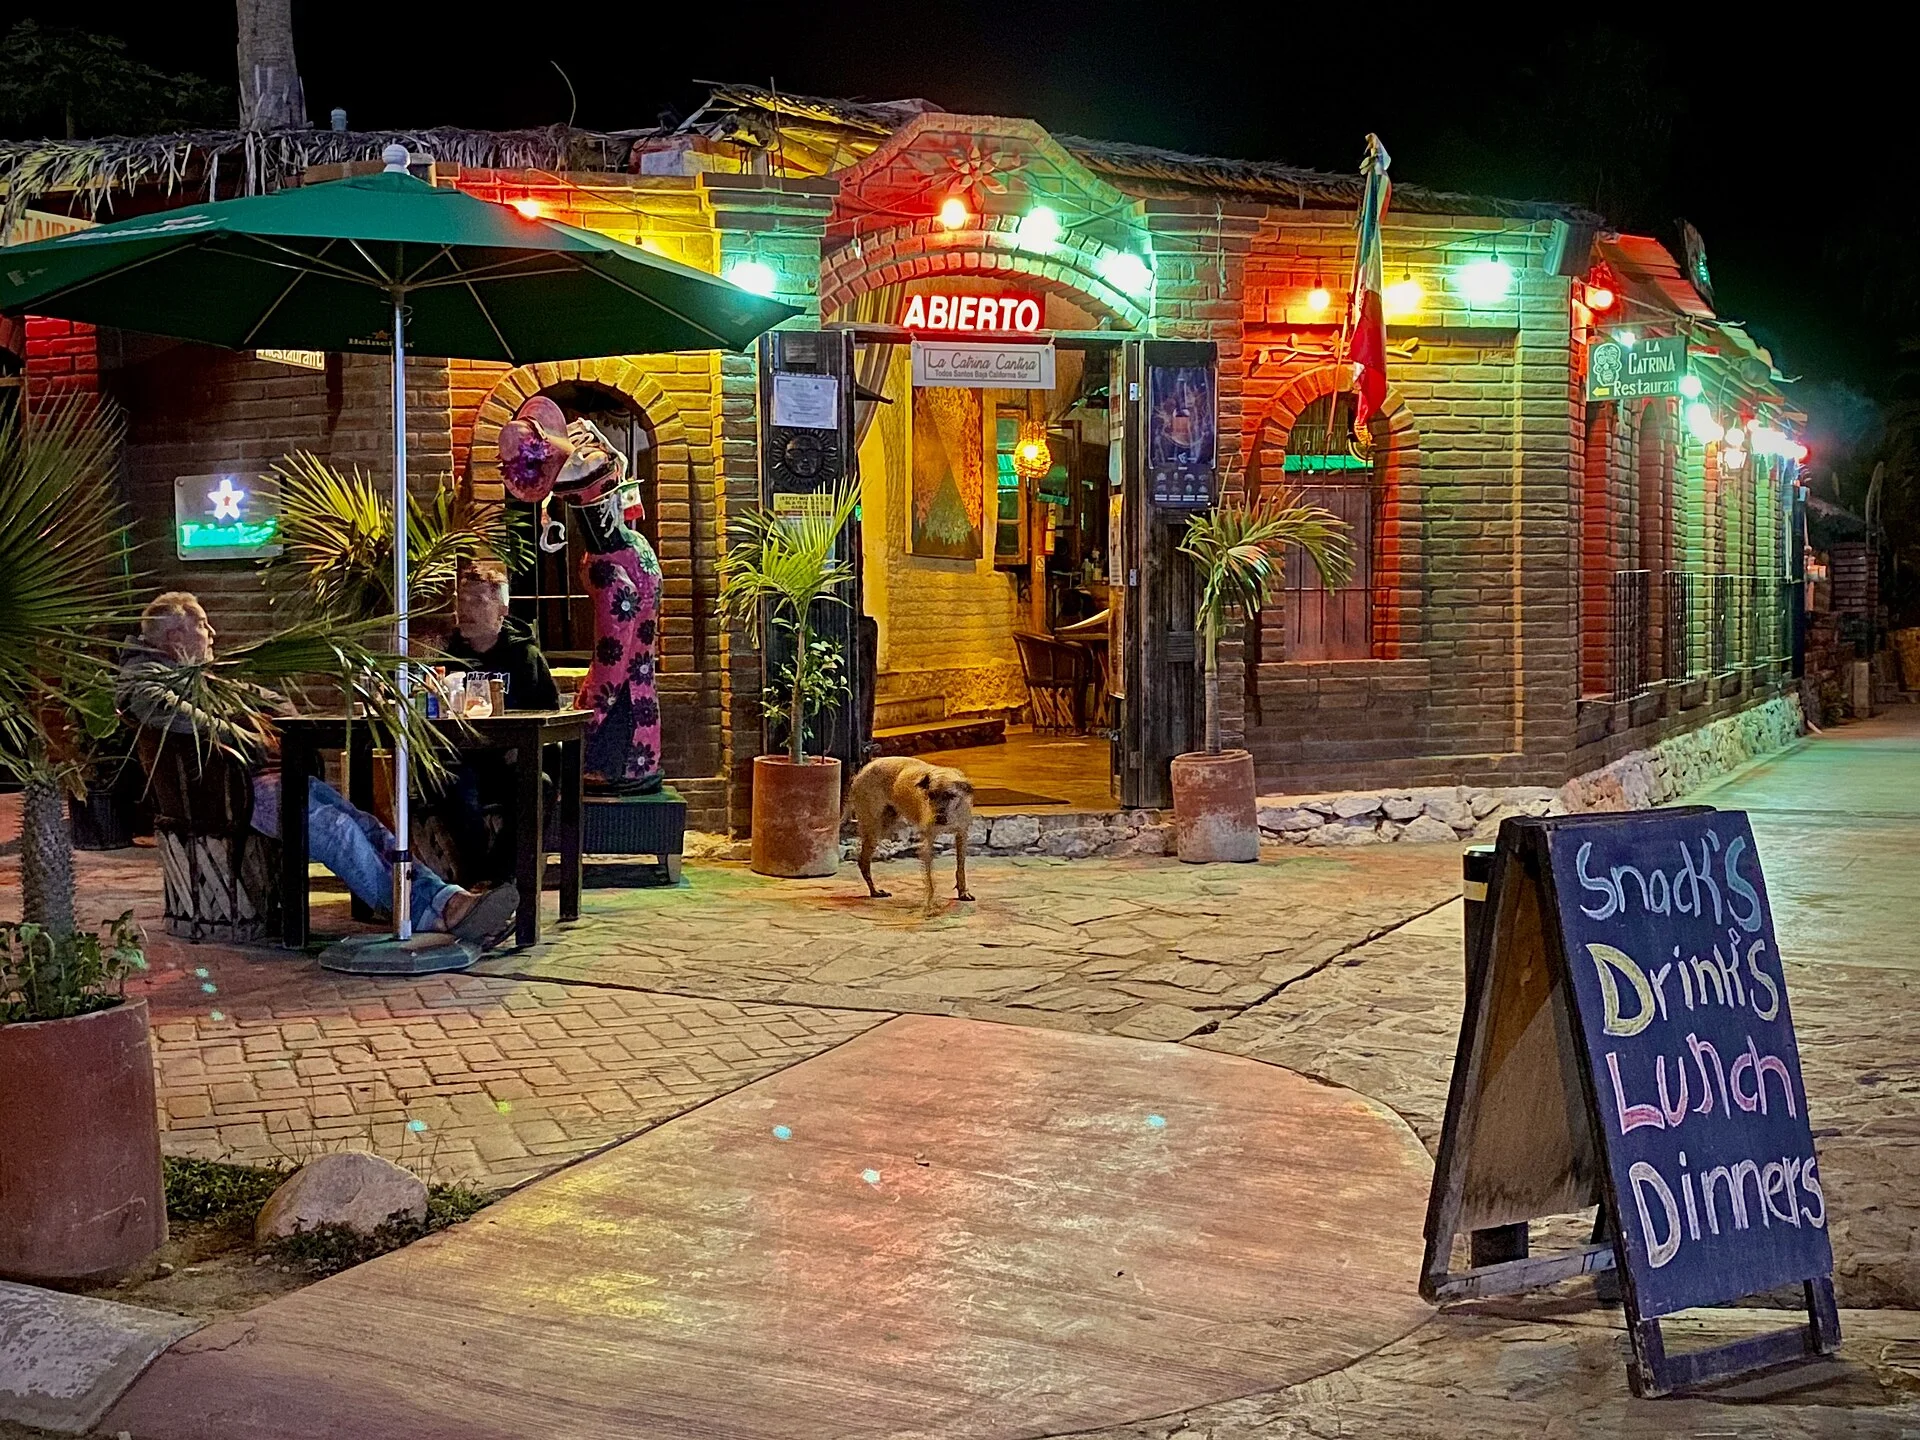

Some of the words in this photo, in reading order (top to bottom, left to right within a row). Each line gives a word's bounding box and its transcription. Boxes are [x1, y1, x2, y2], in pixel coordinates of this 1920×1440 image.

[903, 294, 1039, 332] ABIERTO
[1646, 341, 1660, 352] LA
[927, 351, 946, 368] La
[951, 352, 991, 369] Catrina
[996, 353, 1037, 371] Cantina
[935, 369, 952, 377] Todos
[954, 370, 973, 378] Santos
[975, 370, 988, 379] Baja
[989, 370, 1016, 378] California
[1017, 371, 1028, 379] Sur
[1613, 379, 1677, 396] Restauran
[1605, 1032, 1797, 1136] Lunch
[1628, 1152, 1826, 1269] Dinners
